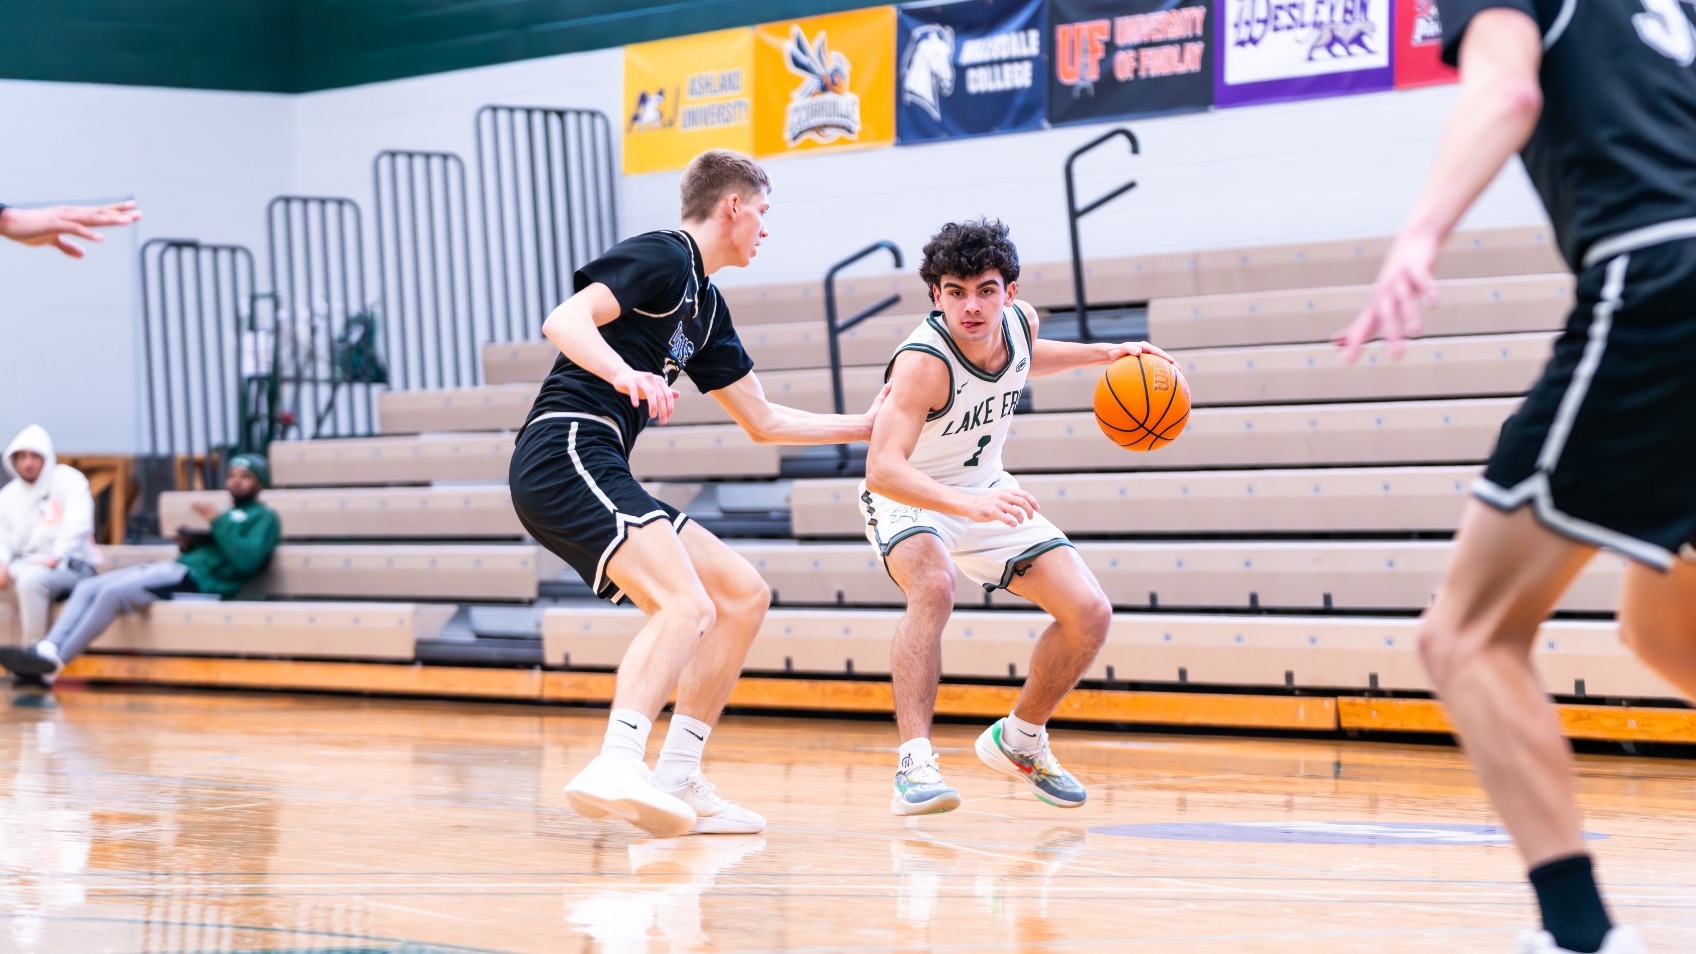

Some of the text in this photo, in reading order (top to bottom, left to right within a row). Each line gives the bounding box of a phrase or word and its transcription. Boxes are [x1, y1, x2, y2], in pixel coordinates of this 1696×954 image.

[958, 29, 1040, 64] HILLSDALE
[1113, 5, 1207, 47] UNIVERSITY
[966, 60, 1033, 95] COLLEGE
[1113, 41, 1205, 82] OF FINDLAY
[941, 389, 1022, 436] LAKE ER
